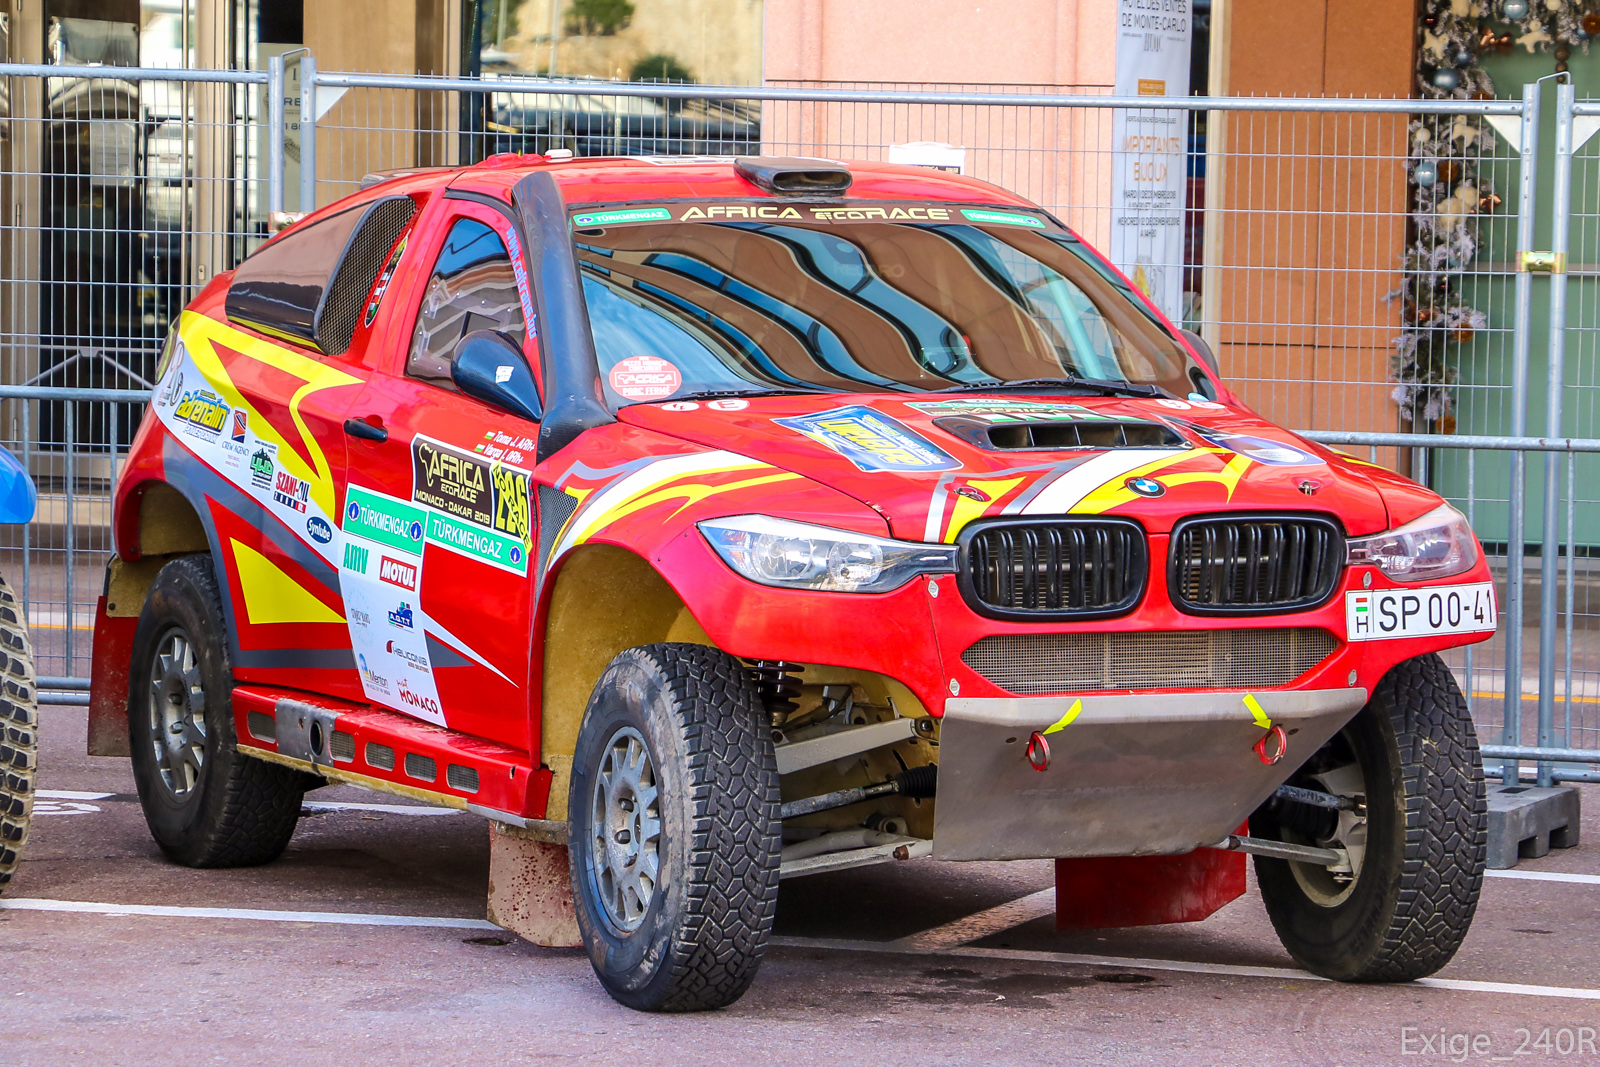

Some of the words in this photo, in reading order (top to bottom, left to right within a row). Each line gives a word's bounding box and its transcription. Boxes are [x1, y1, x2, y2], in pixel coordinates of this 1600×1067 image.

[1122, 12, 1132, 27] DE
[1134, 14, 1187, 32] MONTE-CARLO
[1122, 136, 1181, 156] IMPORTANTS
[1134, 162, 1167, 181] BIJOUX
[595, 211, 665, 222] TÜRKMENGAZ
[680, 206, 803, 222] AFRICA
[505, 226, 538, 340] www.celtrans.hu
[623, 387, 644, 396] PARC
[646, 385, 671, 395] FERMÉ
[429, 450, 485, 492] AFRICA
[276, 471, 310, 502] SZANI-OIL
[440, 478, 477, 504] ECORACE
[416, 489, 444, 508] MONACO
[448, 501, 472, 519] DAKAR
[474, 510, 491, 525] 2019
[360, 504, 411, 539] TÜRKMENGAZ
[433, 518, 502, 559] TÜRKMENGAZ
[381, 560, 415, 588] MOTUL
[1379, 596, 1420, 632] SP
[1428, 589, 1493, 629] 00-41
[1356, 615, 1369, 634] H
[369, 669, 388, 687] Menton
[399, 688, 439, 715] MONACO
